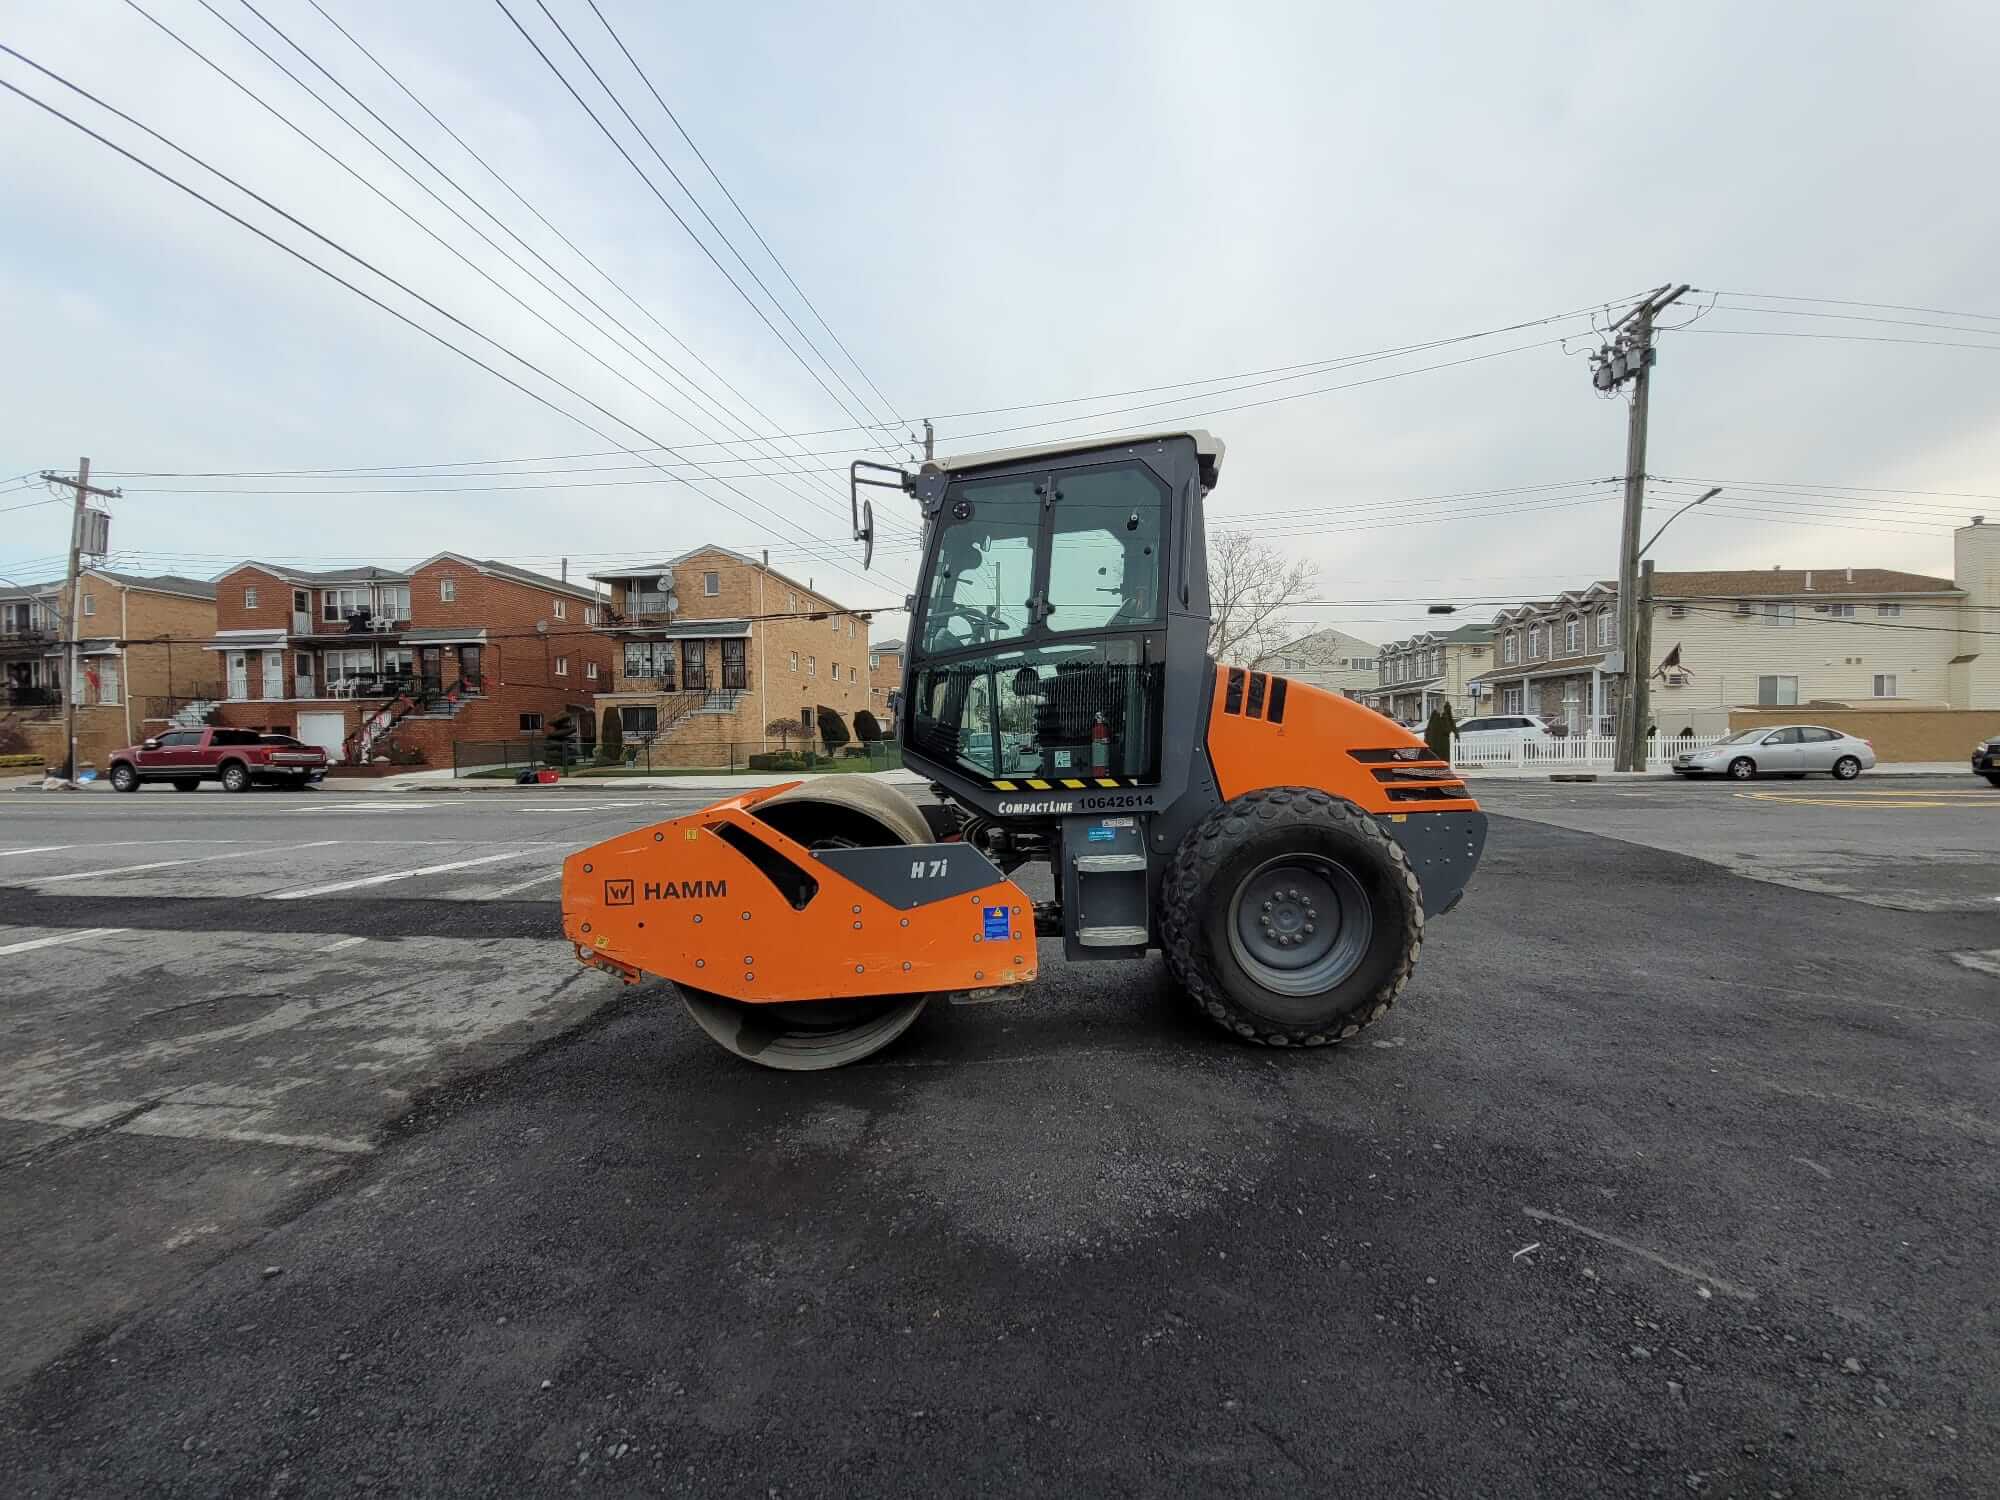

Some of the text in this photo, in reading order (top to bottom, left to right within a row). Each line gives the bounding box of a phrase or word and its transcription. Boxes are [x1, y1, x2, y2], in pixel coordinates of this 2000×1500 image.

[1079, 795, 1155, 809] 10642614
[910, 858, 948, 879] H 7i
[644, 880, 727, 901] HAMM
